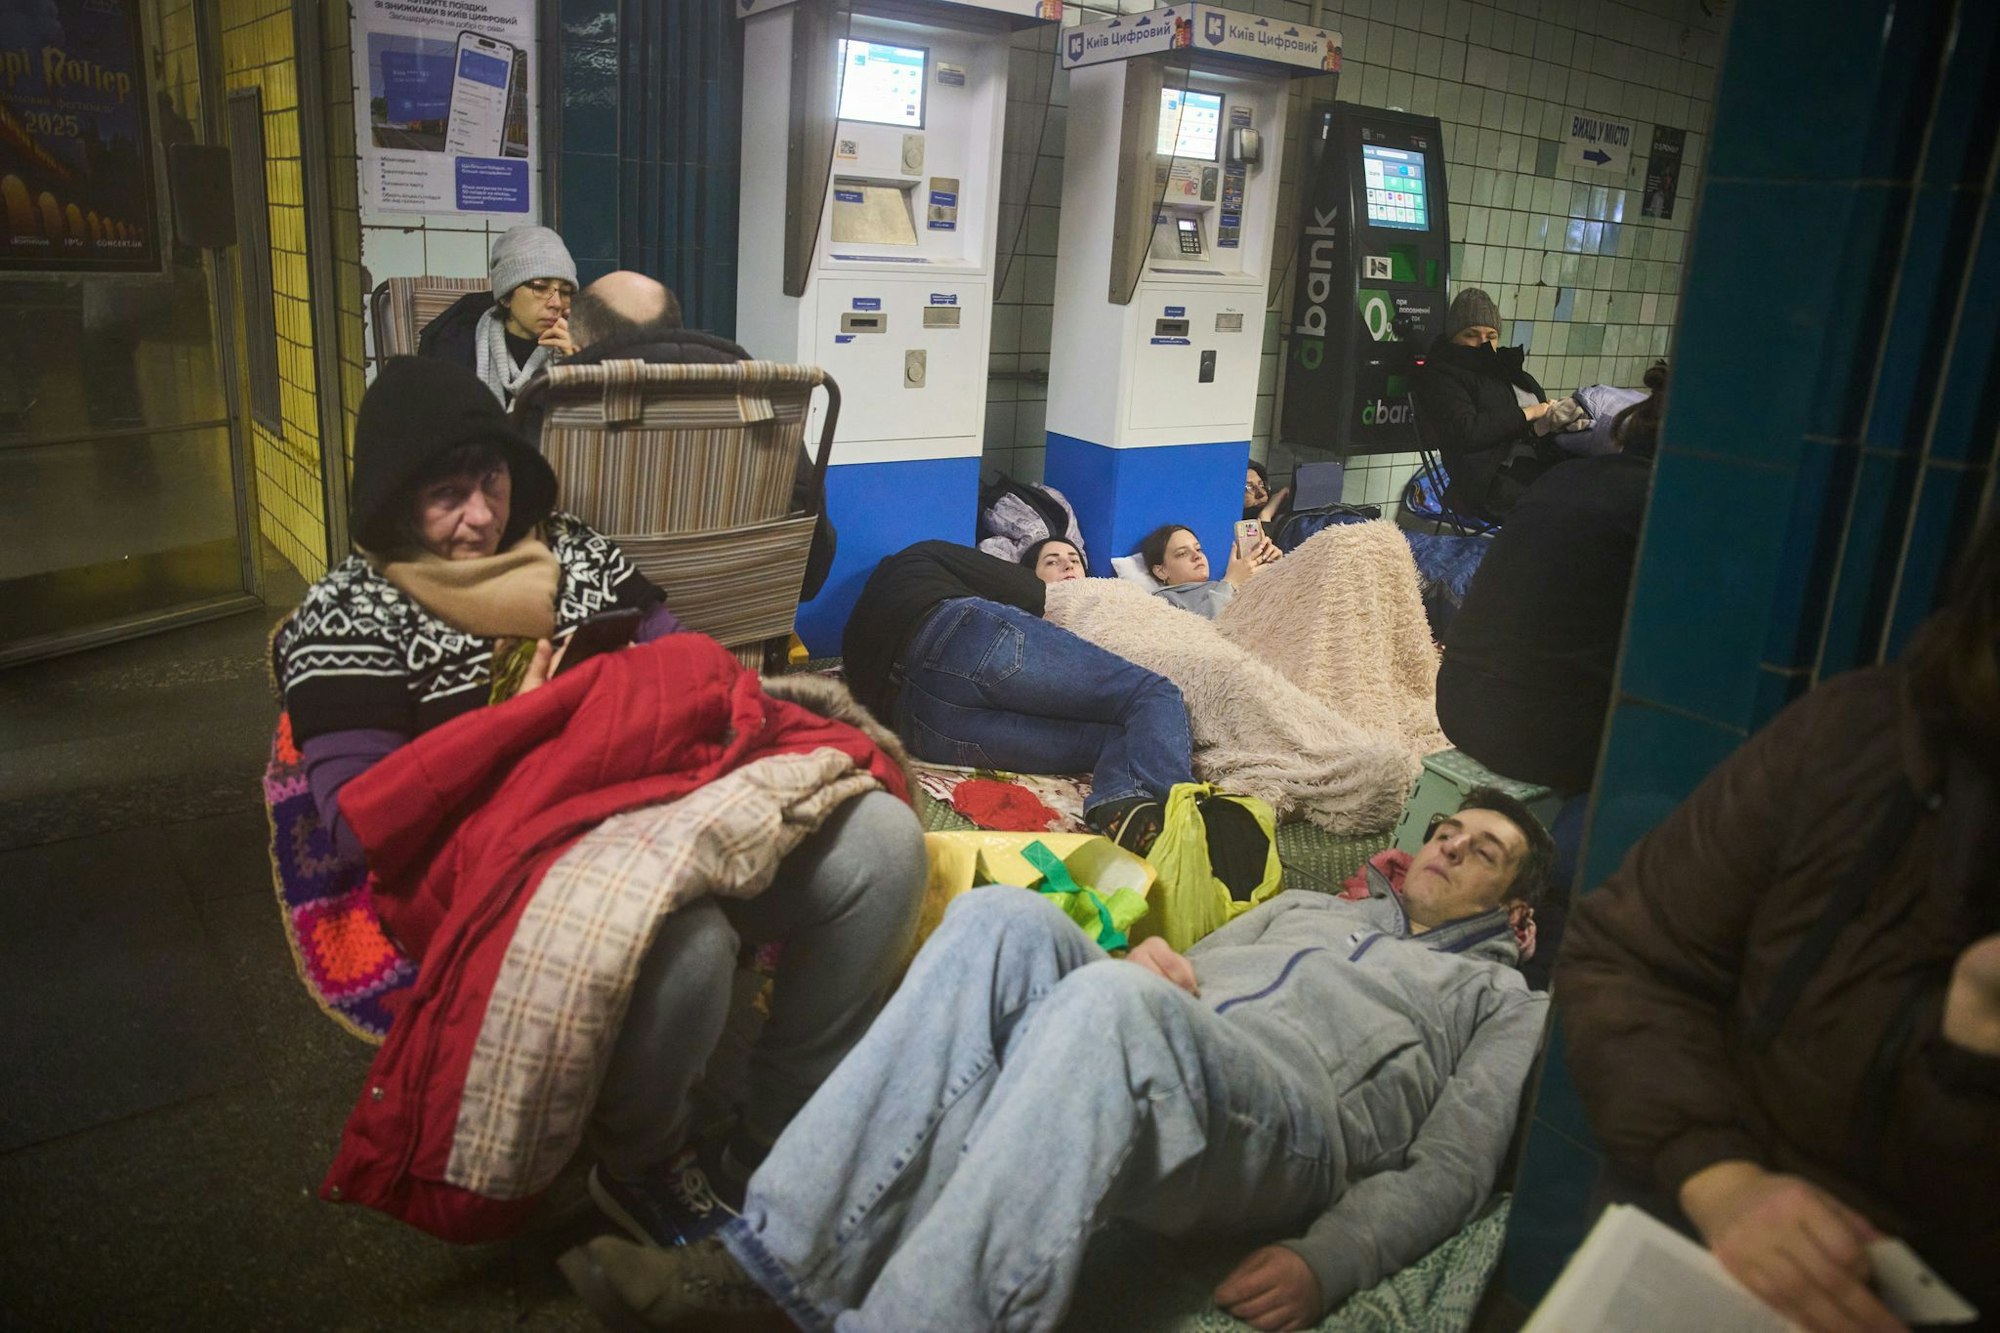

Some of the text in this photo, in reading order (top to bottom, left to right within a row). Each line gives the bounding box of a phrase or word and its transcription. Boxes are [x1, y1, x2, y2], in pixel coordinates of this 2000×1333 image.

[384, 1, 438, 16] ЗНИЖКАМИ
[440, 9, 446, 17] В
[447, 10, 468, 20] КИЇВ
[468, 12, 518, 26] ЦИФРОВИЙ
[449, 1, 488, 13] ПОЇЗДКИ
[1087, 35, 1109, 50] Київ
[1111, 22, 1171, 46] Цифровий
[1229, 25, 1255, 42] Київ
[1258, 30, 1318, 54] Цифровий
[41, 45, 131, 104] Поттер
[24, 110, 79, 137] 2025
[1572, 116, 1630, 147] ВИХІД У МІСТО
